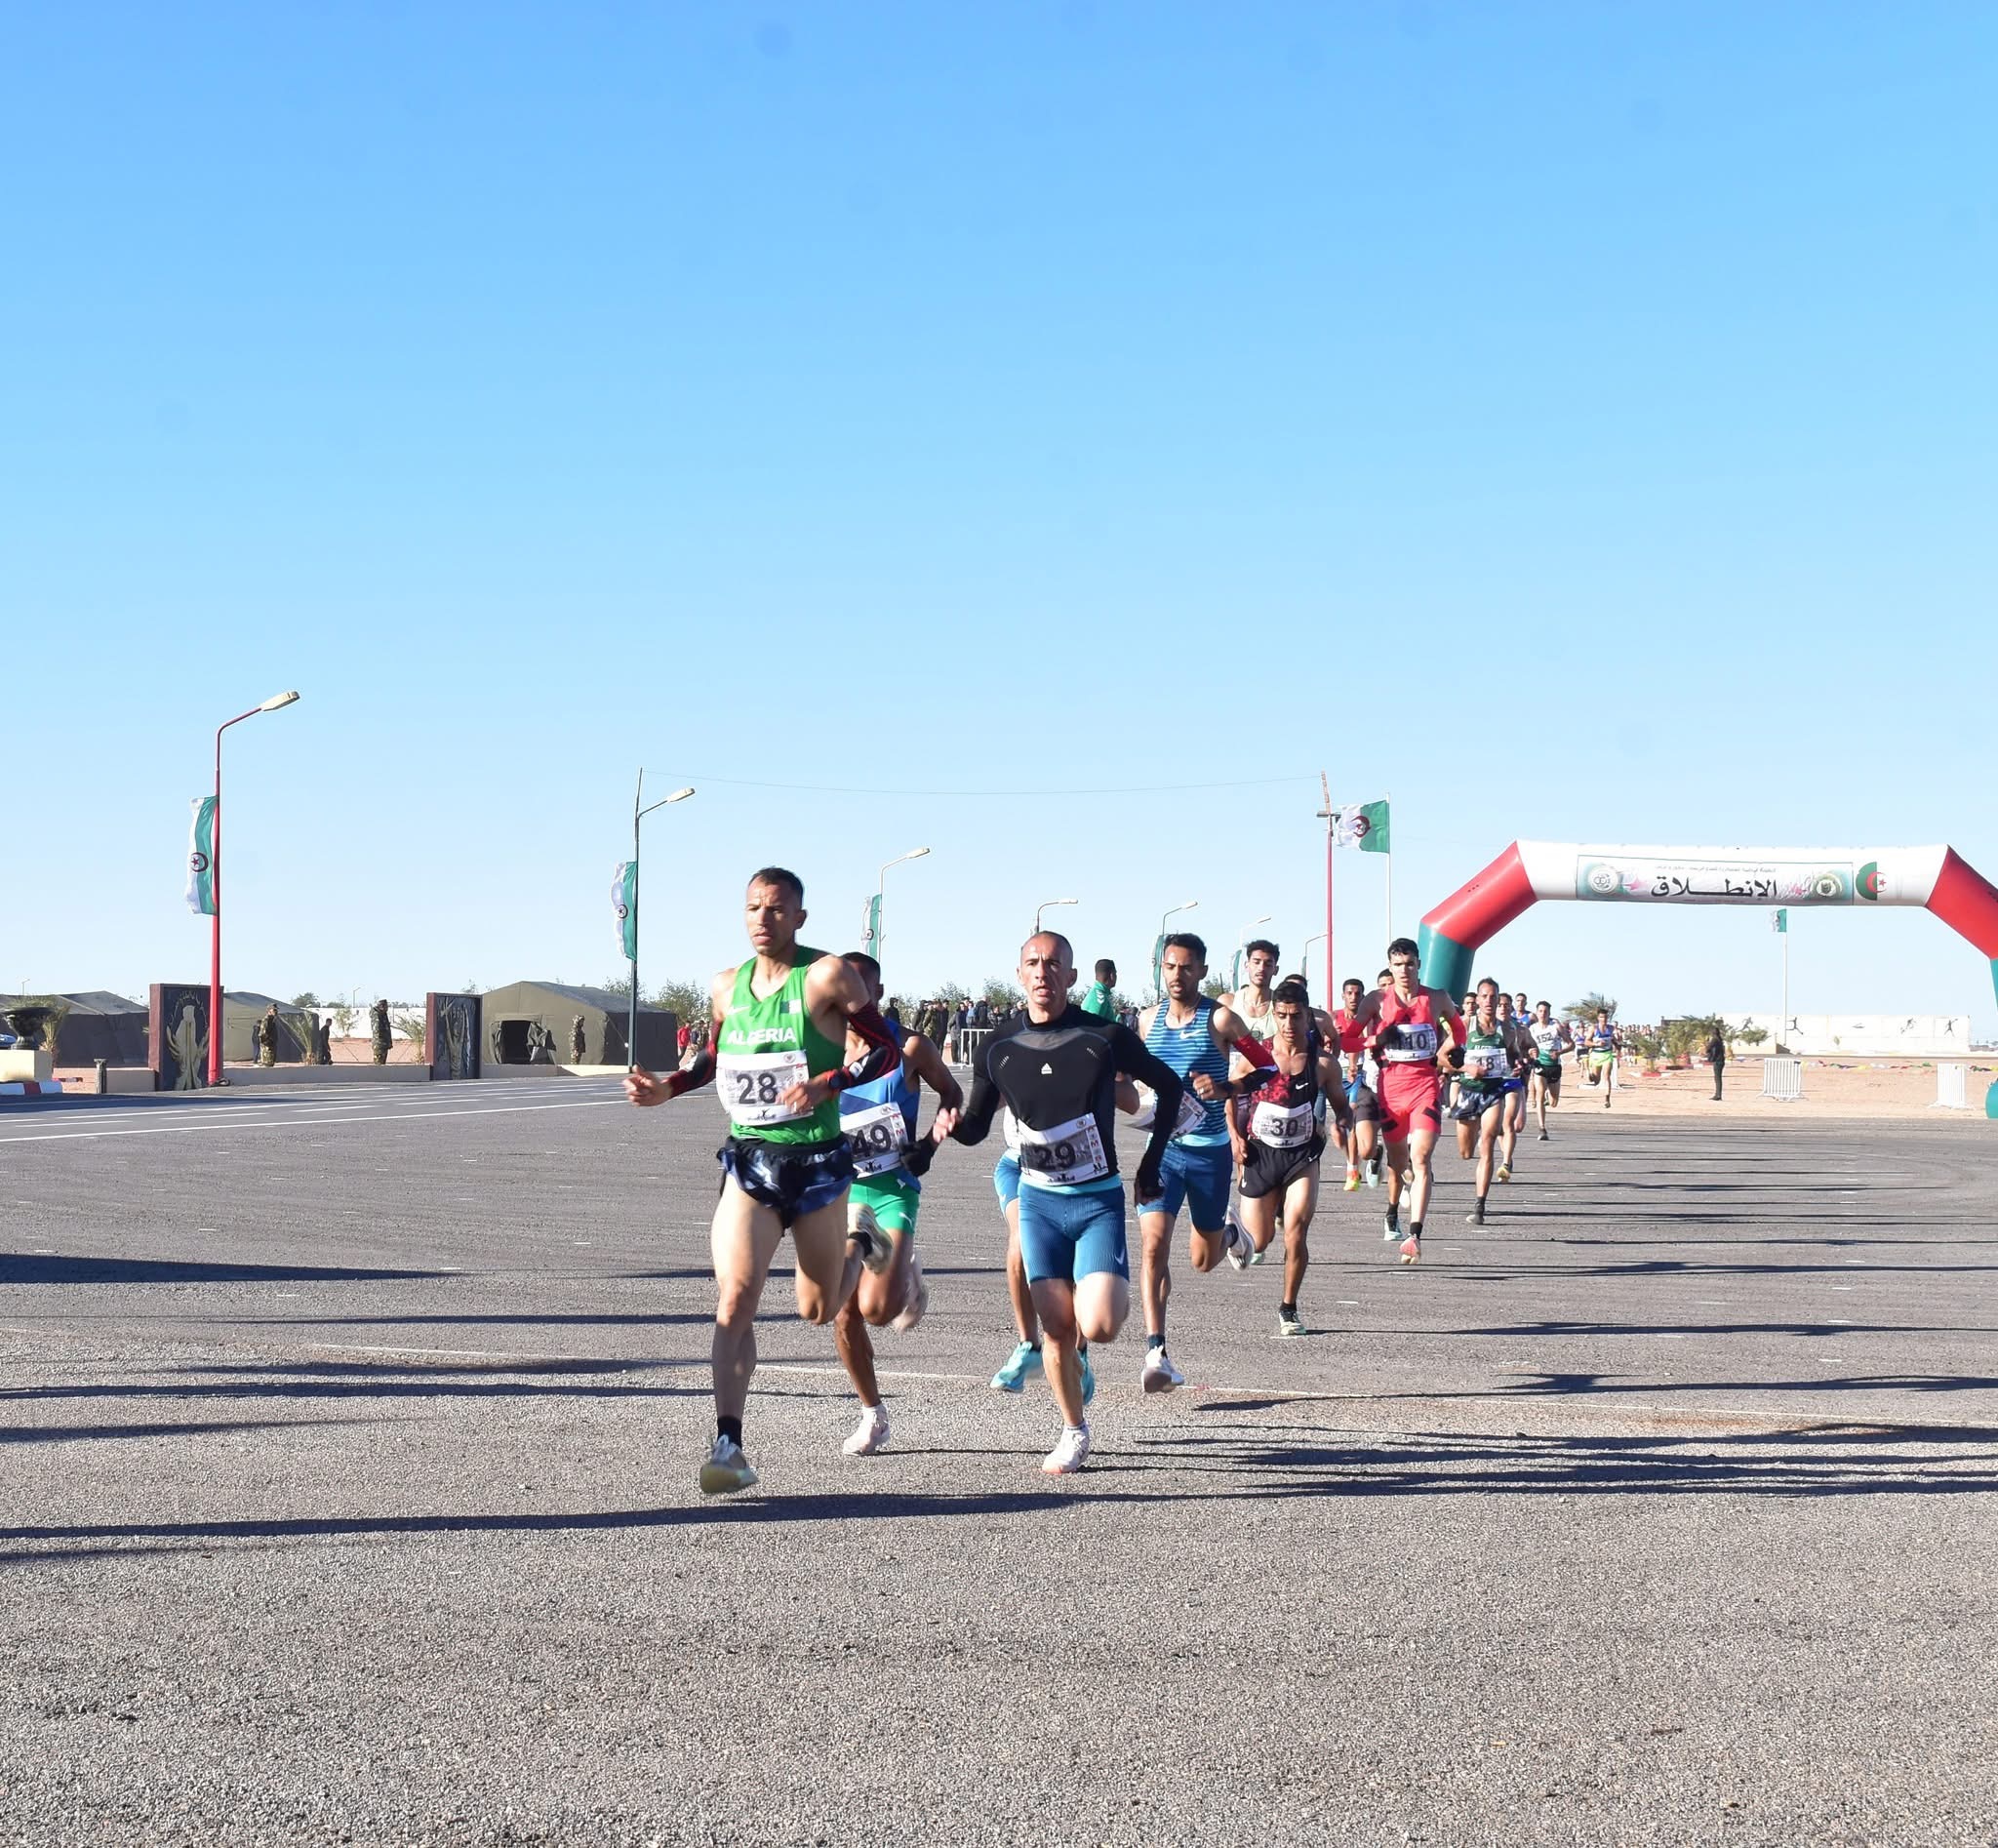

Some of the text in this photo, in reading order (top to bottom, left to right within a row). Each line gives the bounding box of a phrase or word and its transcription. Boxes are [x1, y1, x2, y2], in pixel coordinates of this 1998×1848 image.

[727, 1027, 797, 1045] ALGERIA
[1537, 1032, 1554, 1044] 152
[737, 1073, 778, 1104] 28
[1270, 1118, 1299, 1136] 30
[852, 1124, 892, 1157] 49
[1034, 1141, 1076, 1170] 29
